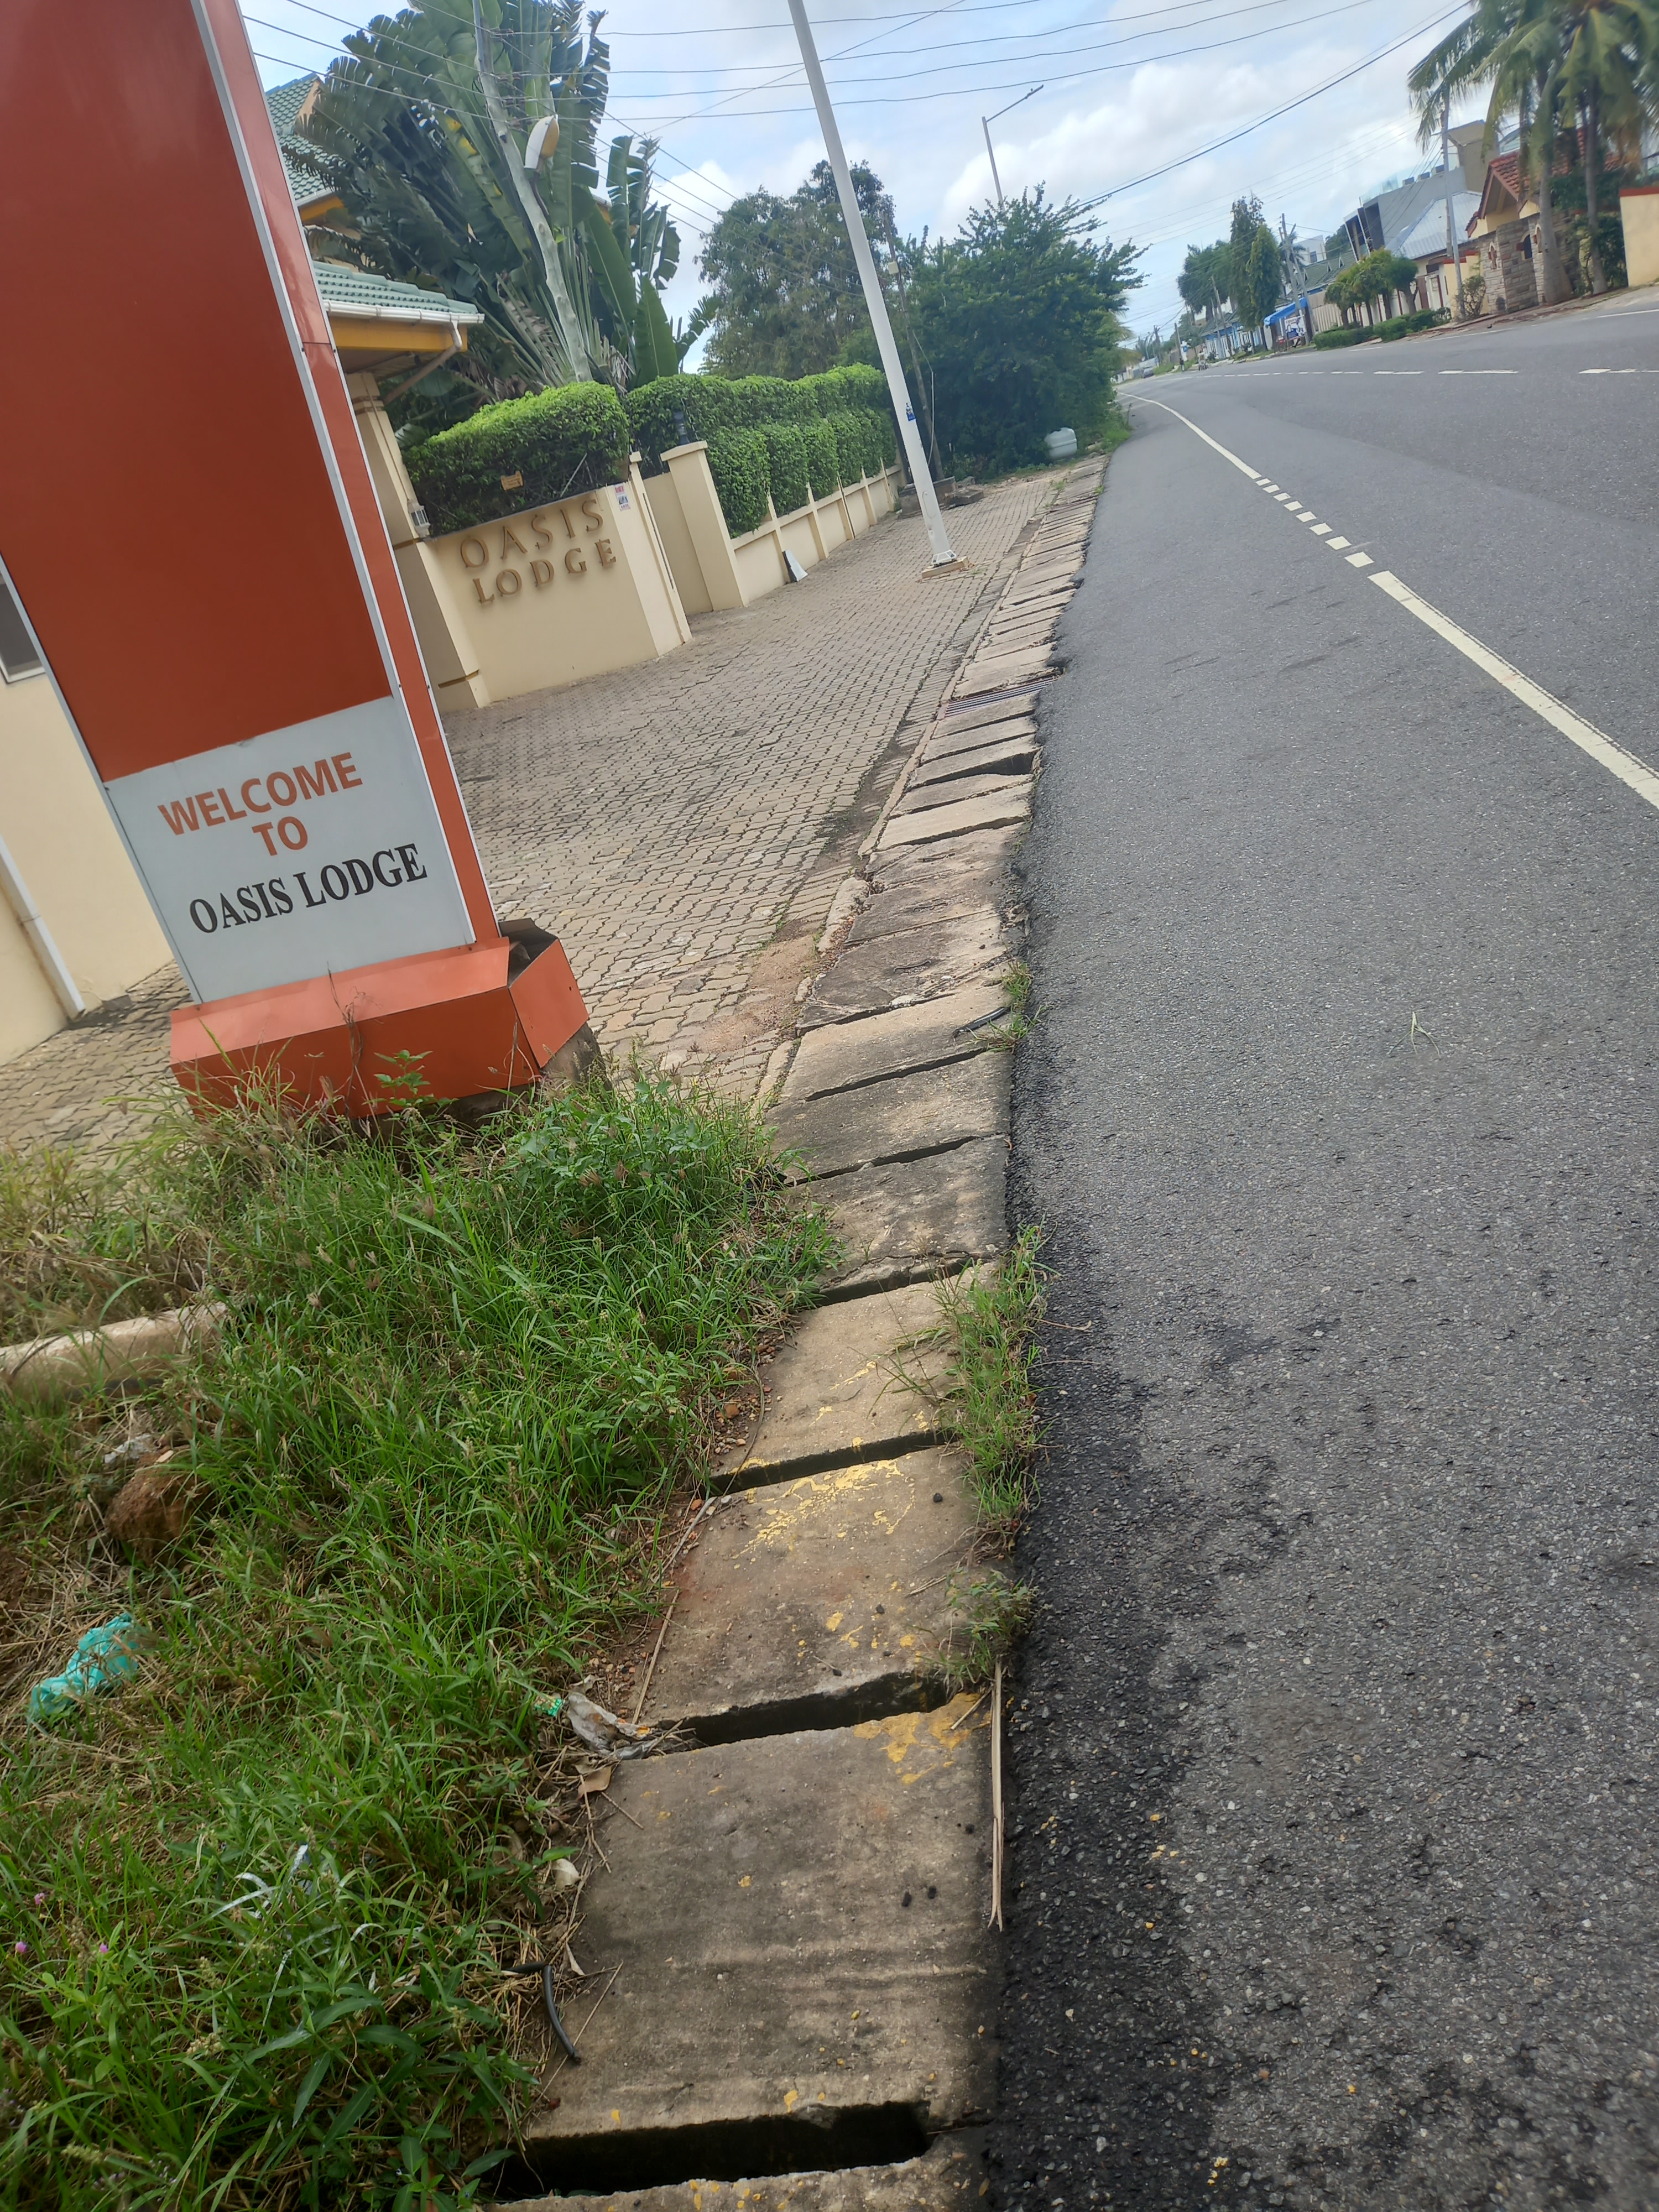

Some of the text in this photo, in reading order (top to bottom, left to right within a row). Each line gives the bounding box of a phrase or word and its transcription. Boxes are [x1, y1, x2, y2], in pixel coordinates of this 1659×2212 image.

[460, 498, 603, 568] OASIS
[473, 539, 617, 604] LODGE
[158, 752, 362, 836] WELCOME
[253, 816, 308, 857] TO
[190, 843, 427, 933] OASIS LODGE
